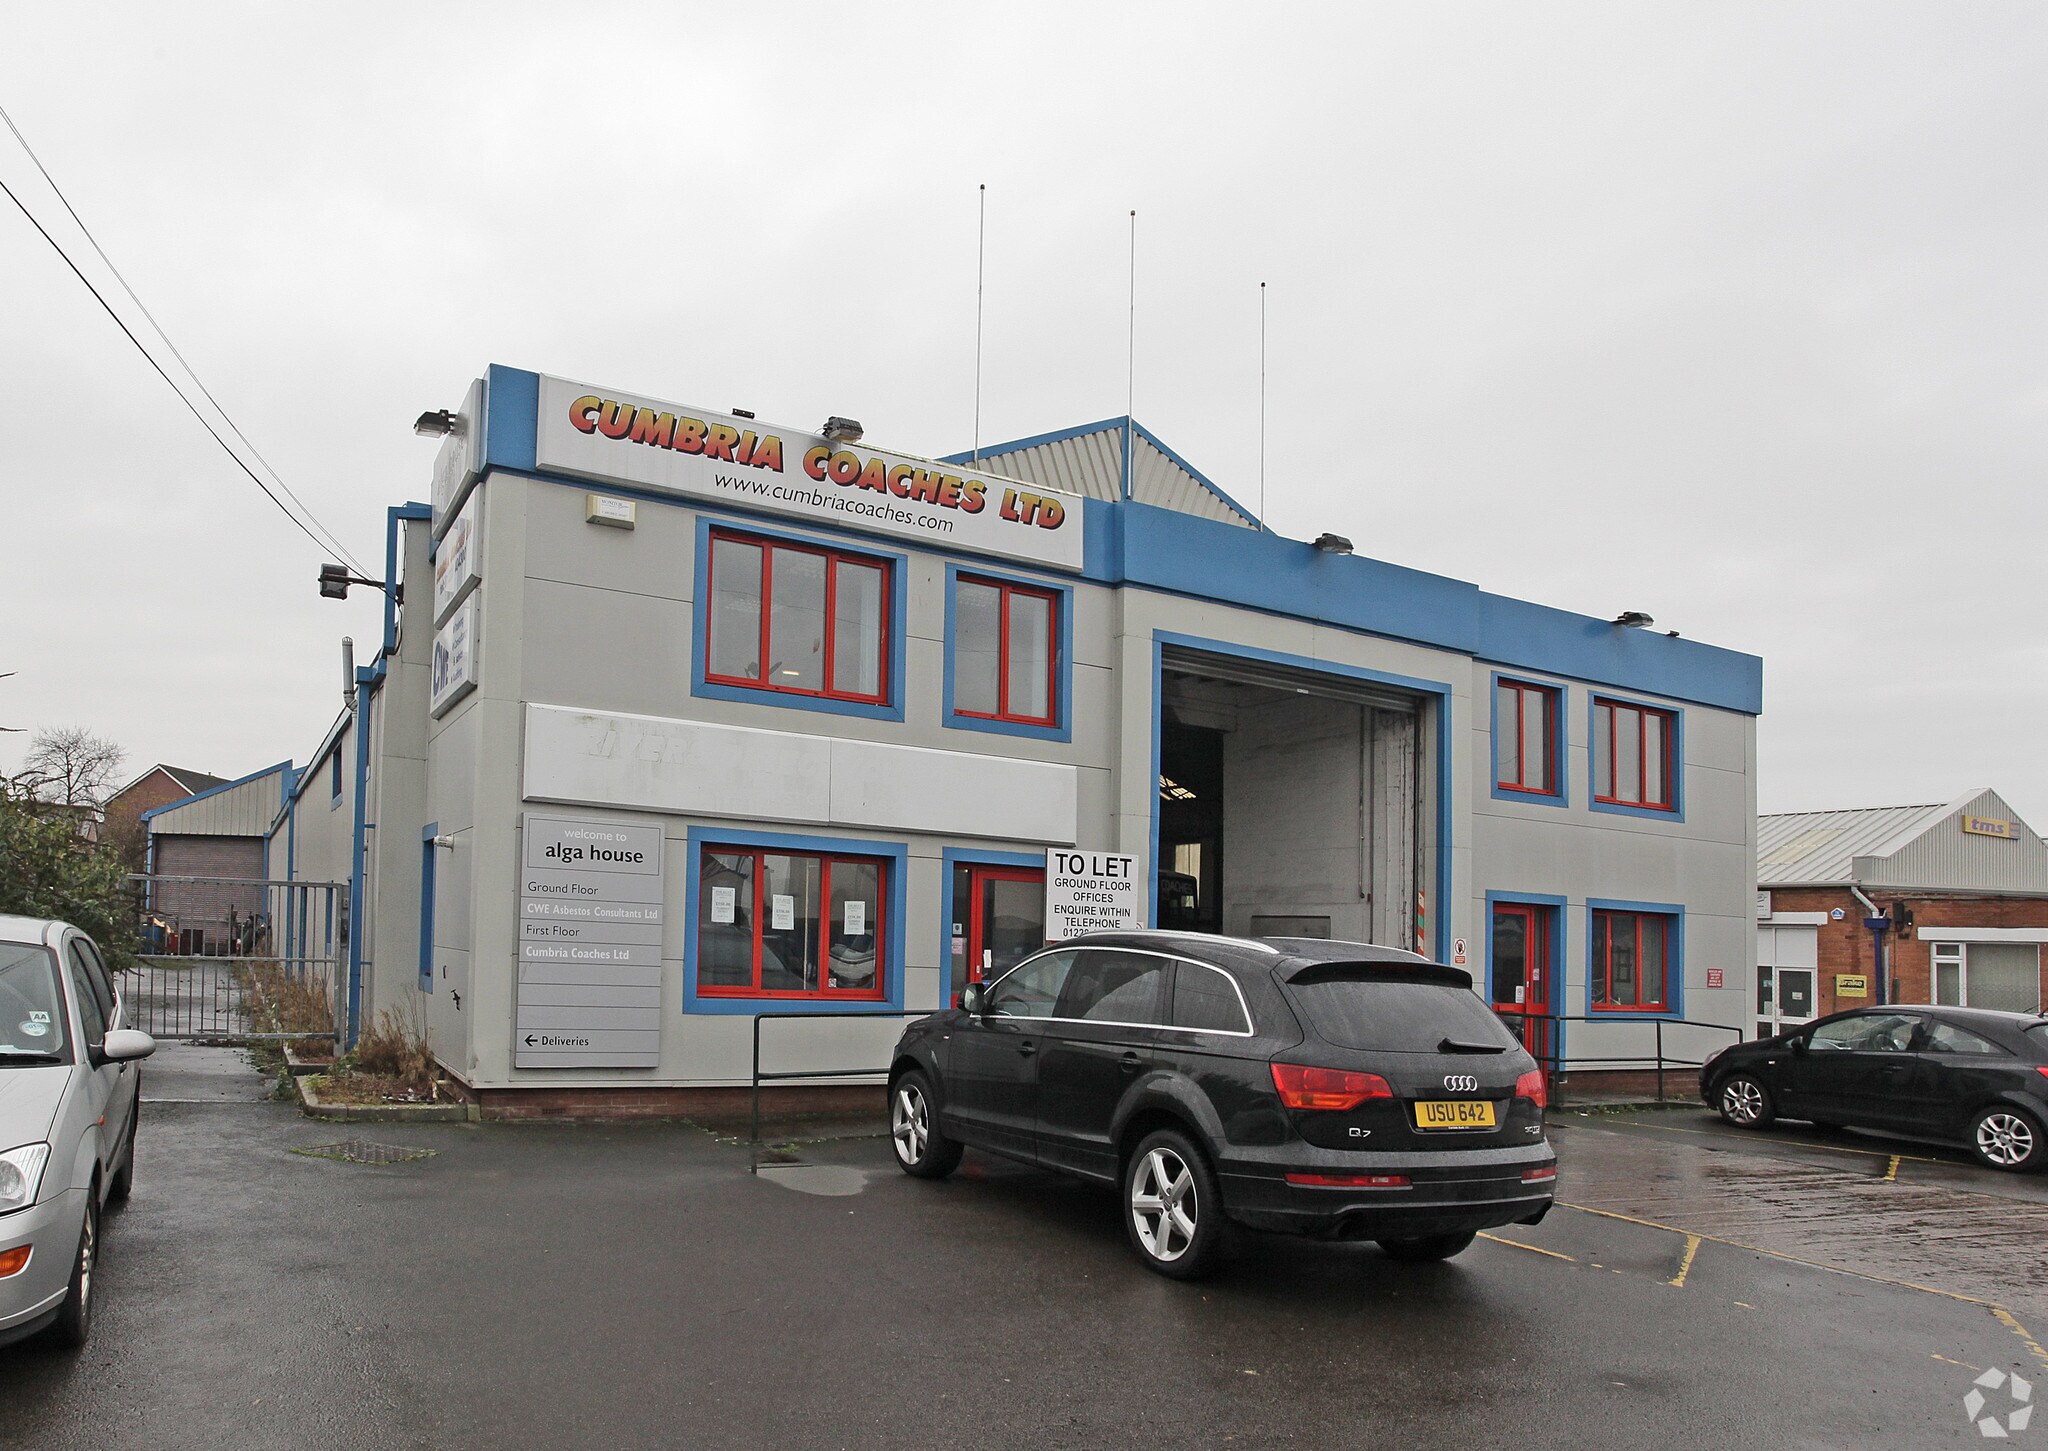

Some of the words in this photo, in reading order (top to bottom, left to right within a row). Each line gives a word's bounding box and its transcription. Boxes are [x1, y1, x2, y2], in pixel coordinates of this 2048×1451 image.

[569, 395, 784, 473] CUMBRIA
[802, 445, 988, 514] COACHES
[999, 487, 1066, 530] LTD
[714, 473, 954, 533] www.cumbriacoaches.com
[1971, 818, 2004, 834] tms
[564, 829, 613, 842] welcome
[616, 831, 627, 842] to
[545, 842, 583, 863] alga
[590, 844, 644, 864] house
[1055, 853, 1085, 875] TO
[1092, 856, 1132, 878] LET
[527, 881, 568, 894] Ground
[571, 883, 599, 896] Floor
[1054, 878, 1097, 890] GROUND
[1099, 881, 1131, 892] FLOOR
[1073, 892, 1114, 903] OFFICES
[527, 903, 550, 914] CWE
[553, 904, 591, 916] Asbestos
[594, 906, 642, 918] Consultants
[645, 908, 658, 919] Ltd
[1054, 904, 1097, 916] ENQUIRE
[1099, 907, 1131, 917] WITHIN
[1065, 917, 1121, 929] TELEPHONE
[526, 924, 549, 936] First
[552, 926, 580, 937] Floor
[526, 946, 568, 958] Cumbria
[571, 948, 611, 960] Coaches
[613, 949, 629, 960] Ltd
[541, 1035, 589, 1047] Deliveries
[1426, 1103, 1455, 1122] USU
[1459, 1103, 1486, 1122] 642
[1348, 1127, 1372, 1139] Q7
